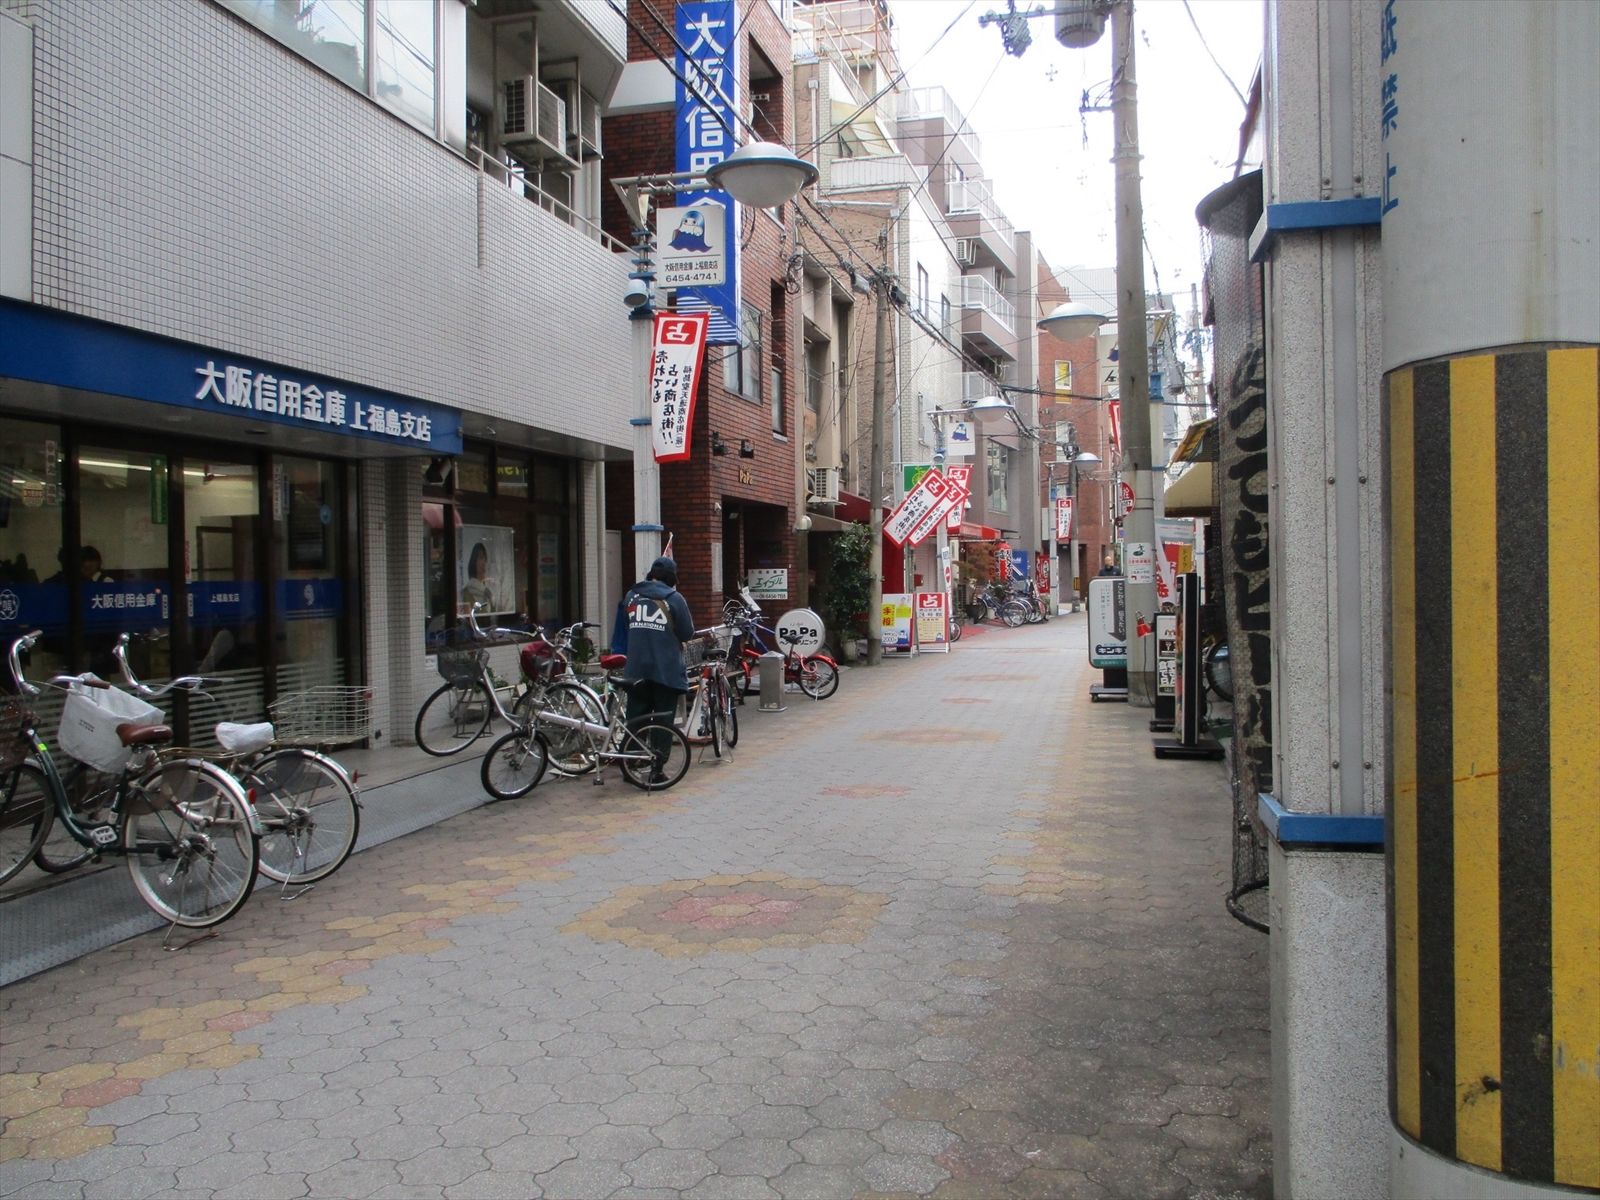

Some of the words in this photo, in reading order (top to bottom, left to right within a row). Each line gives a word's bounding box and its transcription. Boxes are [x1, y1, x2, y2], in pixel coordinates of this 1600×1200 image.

[685, 12, 727, 208] 大阪信用
[664, 262, 693, 272] 大阪信用金庫
[194, 361, 347, 426] 大阪信用金庫
[349, 401, 431, 442] 上福島支店
[750, 574, 785, 589] エイブル
[91, 592, 156, 610] 大阪信用金庫
[626, 604, 667, 624] FILA
[779, 626, 817, 639] PaPa
